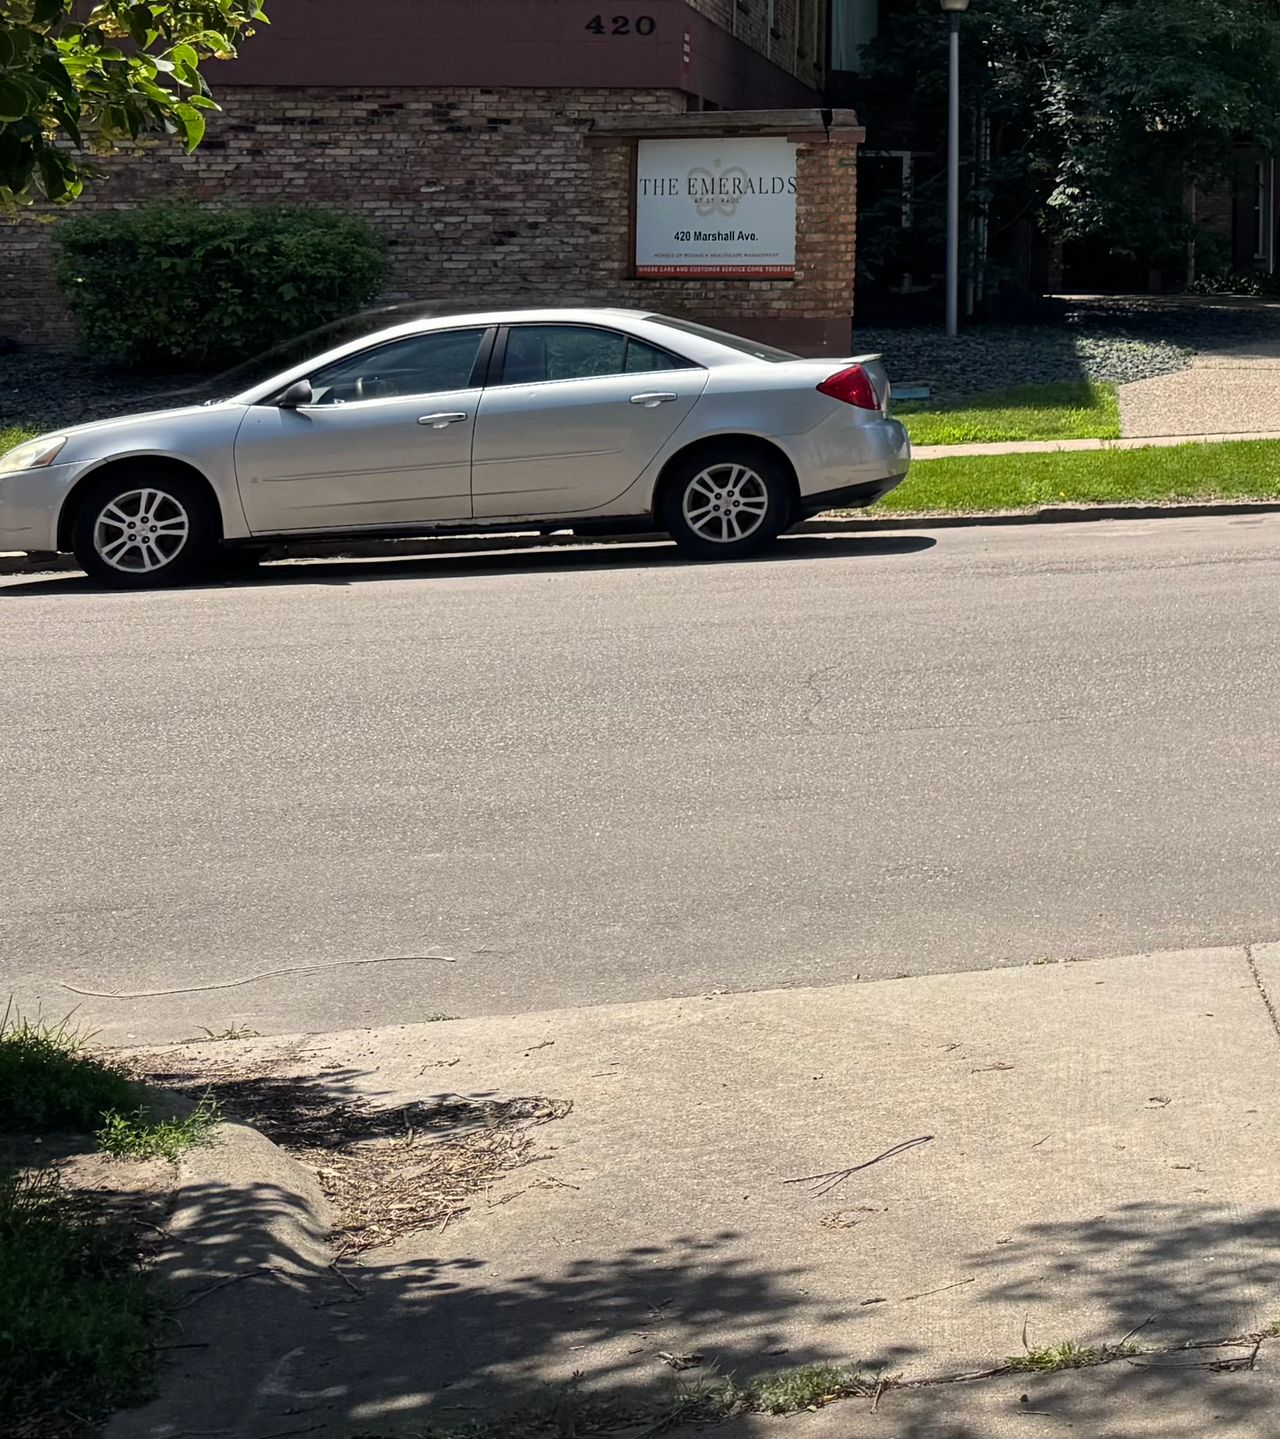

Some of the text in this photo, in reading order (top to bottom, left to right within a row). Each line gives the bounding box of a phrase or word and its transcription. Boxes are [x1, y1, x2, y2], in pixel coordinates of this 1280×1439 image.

[585, 14, 656, 36] 420
[639, 176, 797, 196] THE EMERALDS
[674, 230, 759, 242] 420 Marshall Ave.
